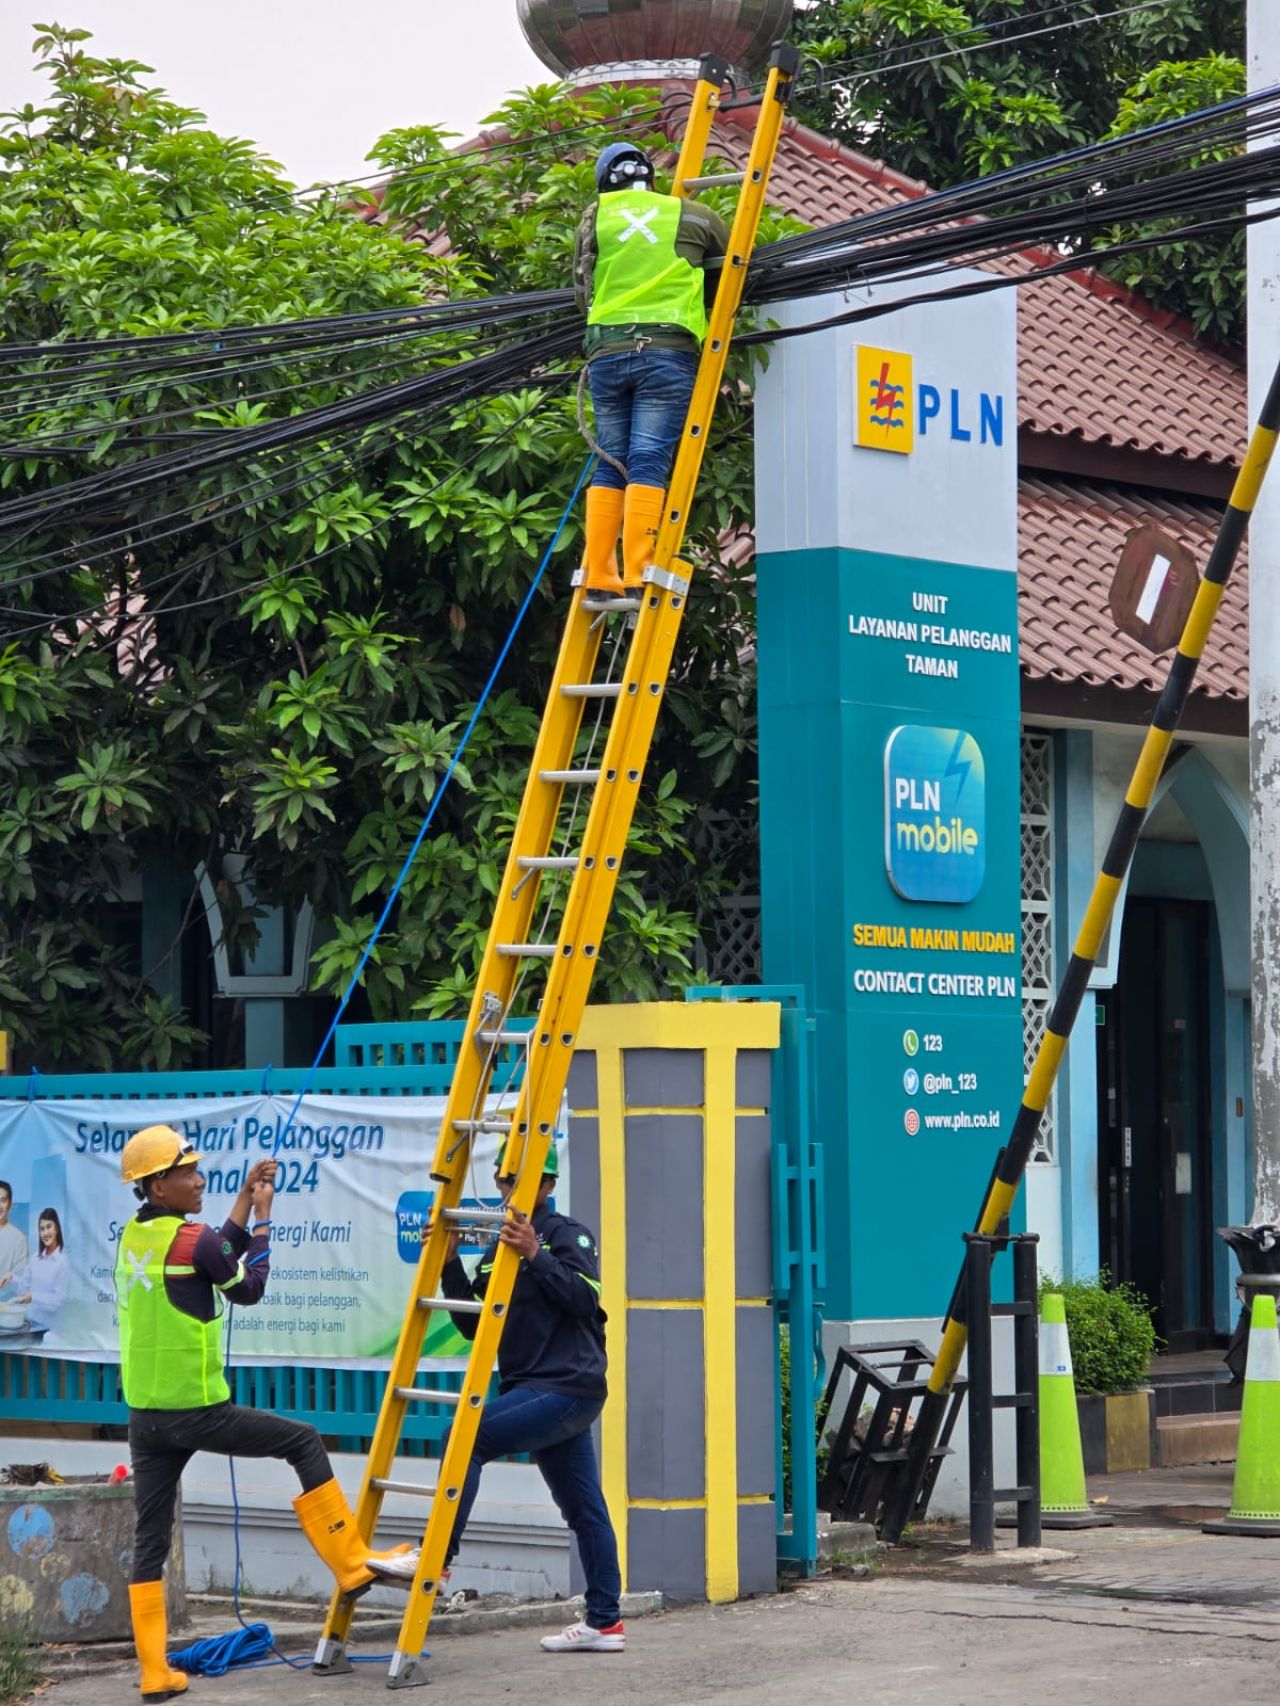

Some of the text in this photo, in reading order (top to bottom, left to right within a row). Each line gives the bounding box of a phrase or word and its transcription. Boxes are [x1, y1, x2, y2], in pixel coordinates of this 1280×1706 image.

[919, 384, 1003, 447] PLN
[912, 591, 949, 614] UNIT
[849, 614, 1012, 653] LAYANAN PELANGGAN
[905, 653, 959, 678] TAMAN
[895, 777, 941, 812] PLN
[896, 816, 979, 856] mobile
[853, 923, 1015, 954] SEMUA MAKIN MUDAH
[853, 969, 1016, 998] CONTACT CENTER PLN
[923, 1034, 943, 1052] 123
[923, 1073, 977, 1095] @pln_123
[924, 1110, 1000, 1132] www.pln.co.id
[183, 1118, 238, 1152] Hari
[244, 1115, 384, 1159] Pelanggan
[273, 1160, 319, 1194] 024
[399, 1212, 422, 1227] PLN
[268, 1220, 352, 1248] nergi Kami
[271, 1266, 318, 1281] ekosistem
[320, 1266, 369, 1282] kelistrikan
[284, 1292, 306, 1309] bagi
[267, 1318, 297, 1336] energi
[299, 1318, 320, 1336] bagi
[322, 1319, 346, 1333] kami
